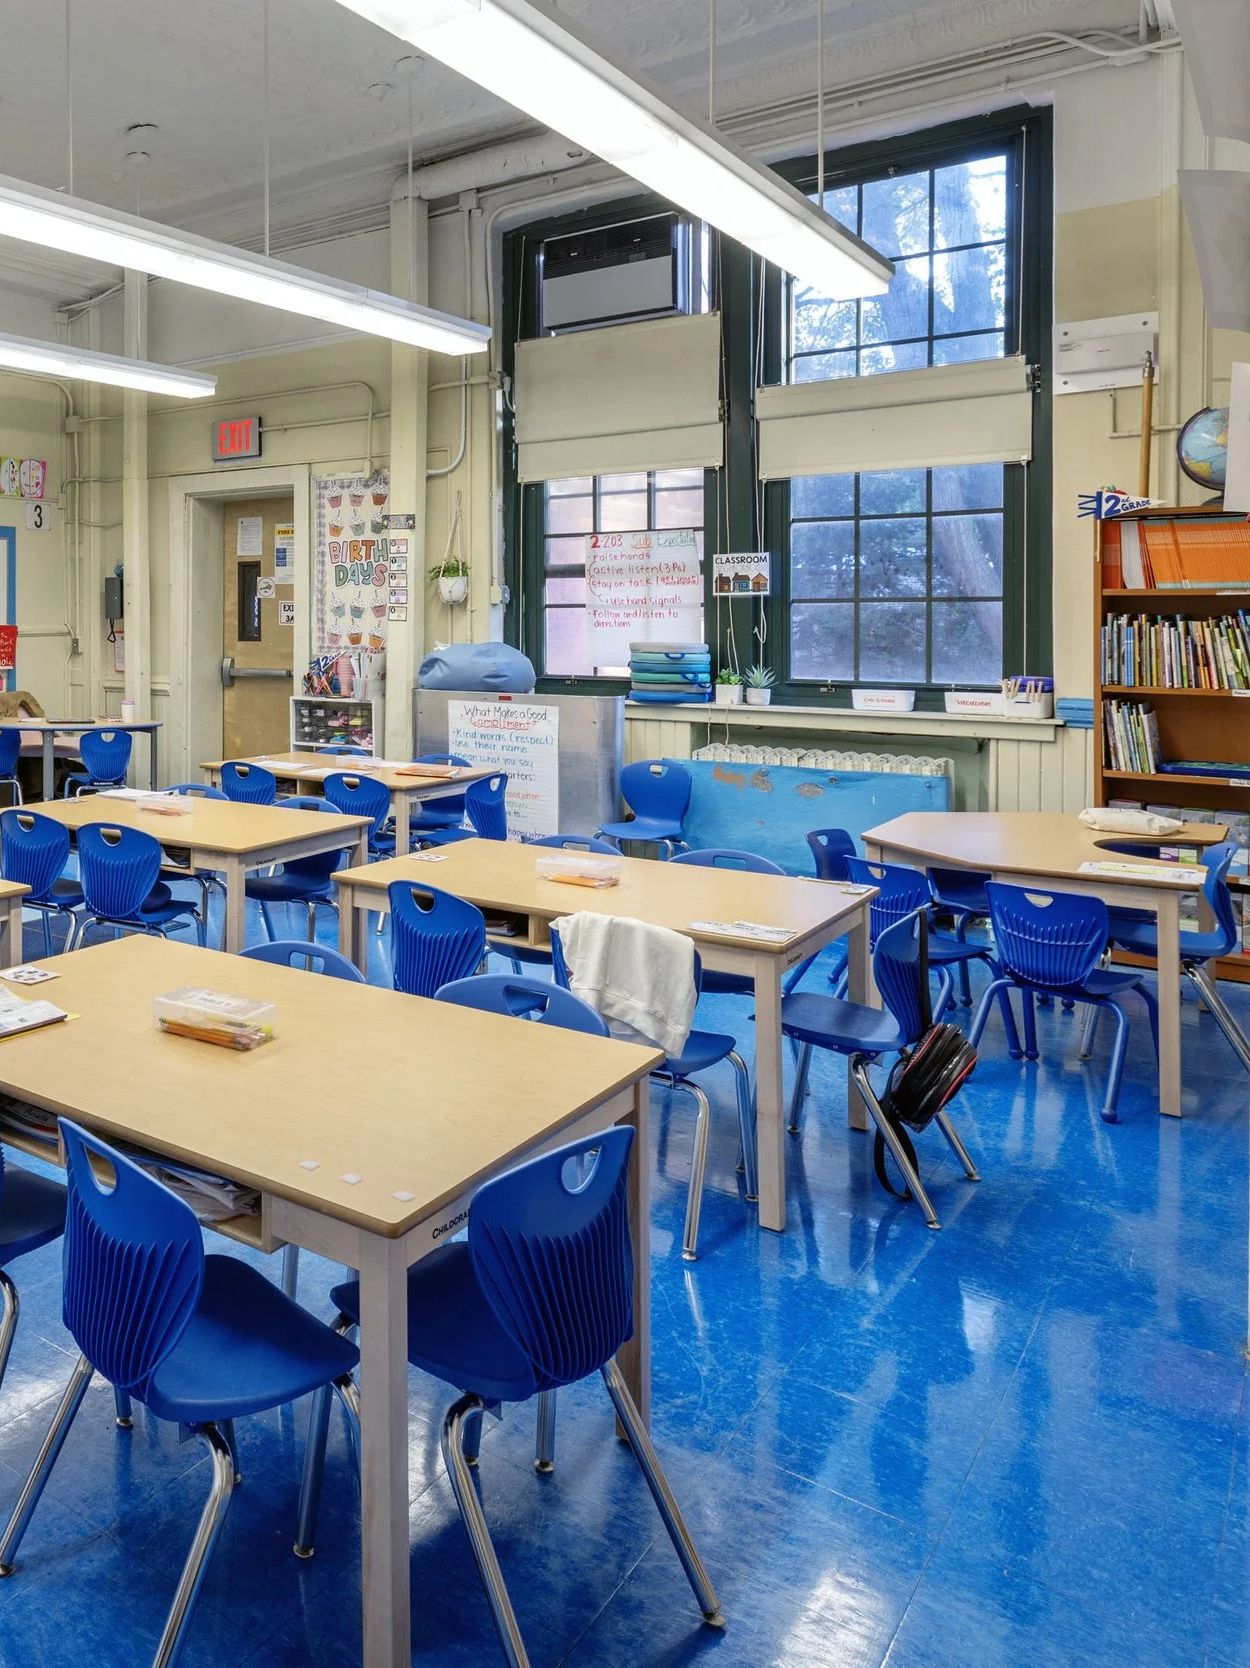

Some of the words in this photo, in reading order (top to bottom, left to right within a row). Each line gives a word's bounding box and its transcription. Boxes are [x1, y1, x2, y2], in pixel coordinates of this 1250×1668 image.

[218, 419, 253, 455] EXIT
[1104, 495, 1121, 517] 2
[1121, 499, 1152, 512] GRADE
[34, 504, 43, 529] 3
[328, 538, 389, 564] BIRTH
[593, 553, 617, 562] raise
[620, 552, 651, 560] hands
[715, 555, 768, 565] CLASSROOM
[334, 560, 388, 588] DAYS
[593, 565, 624, 574] active
[629, 577, 652, 587] task
[626, 596, 647, 605] hand
[650, 594, 682, 607] signals
[593, 619, 631, 628] directions
[321, 655, 330, 668] 2
[464, 704, 491, 717] What
[494, 706, 518, 720] Makes
[527, 707, 547, 720] Good
[480, 732, 506, 740] words
[474, 741, 496, 750] their
[501, 745, 528, 753] name
[480, 755, 500, 764] what
[502, 757, 516, 767] you
